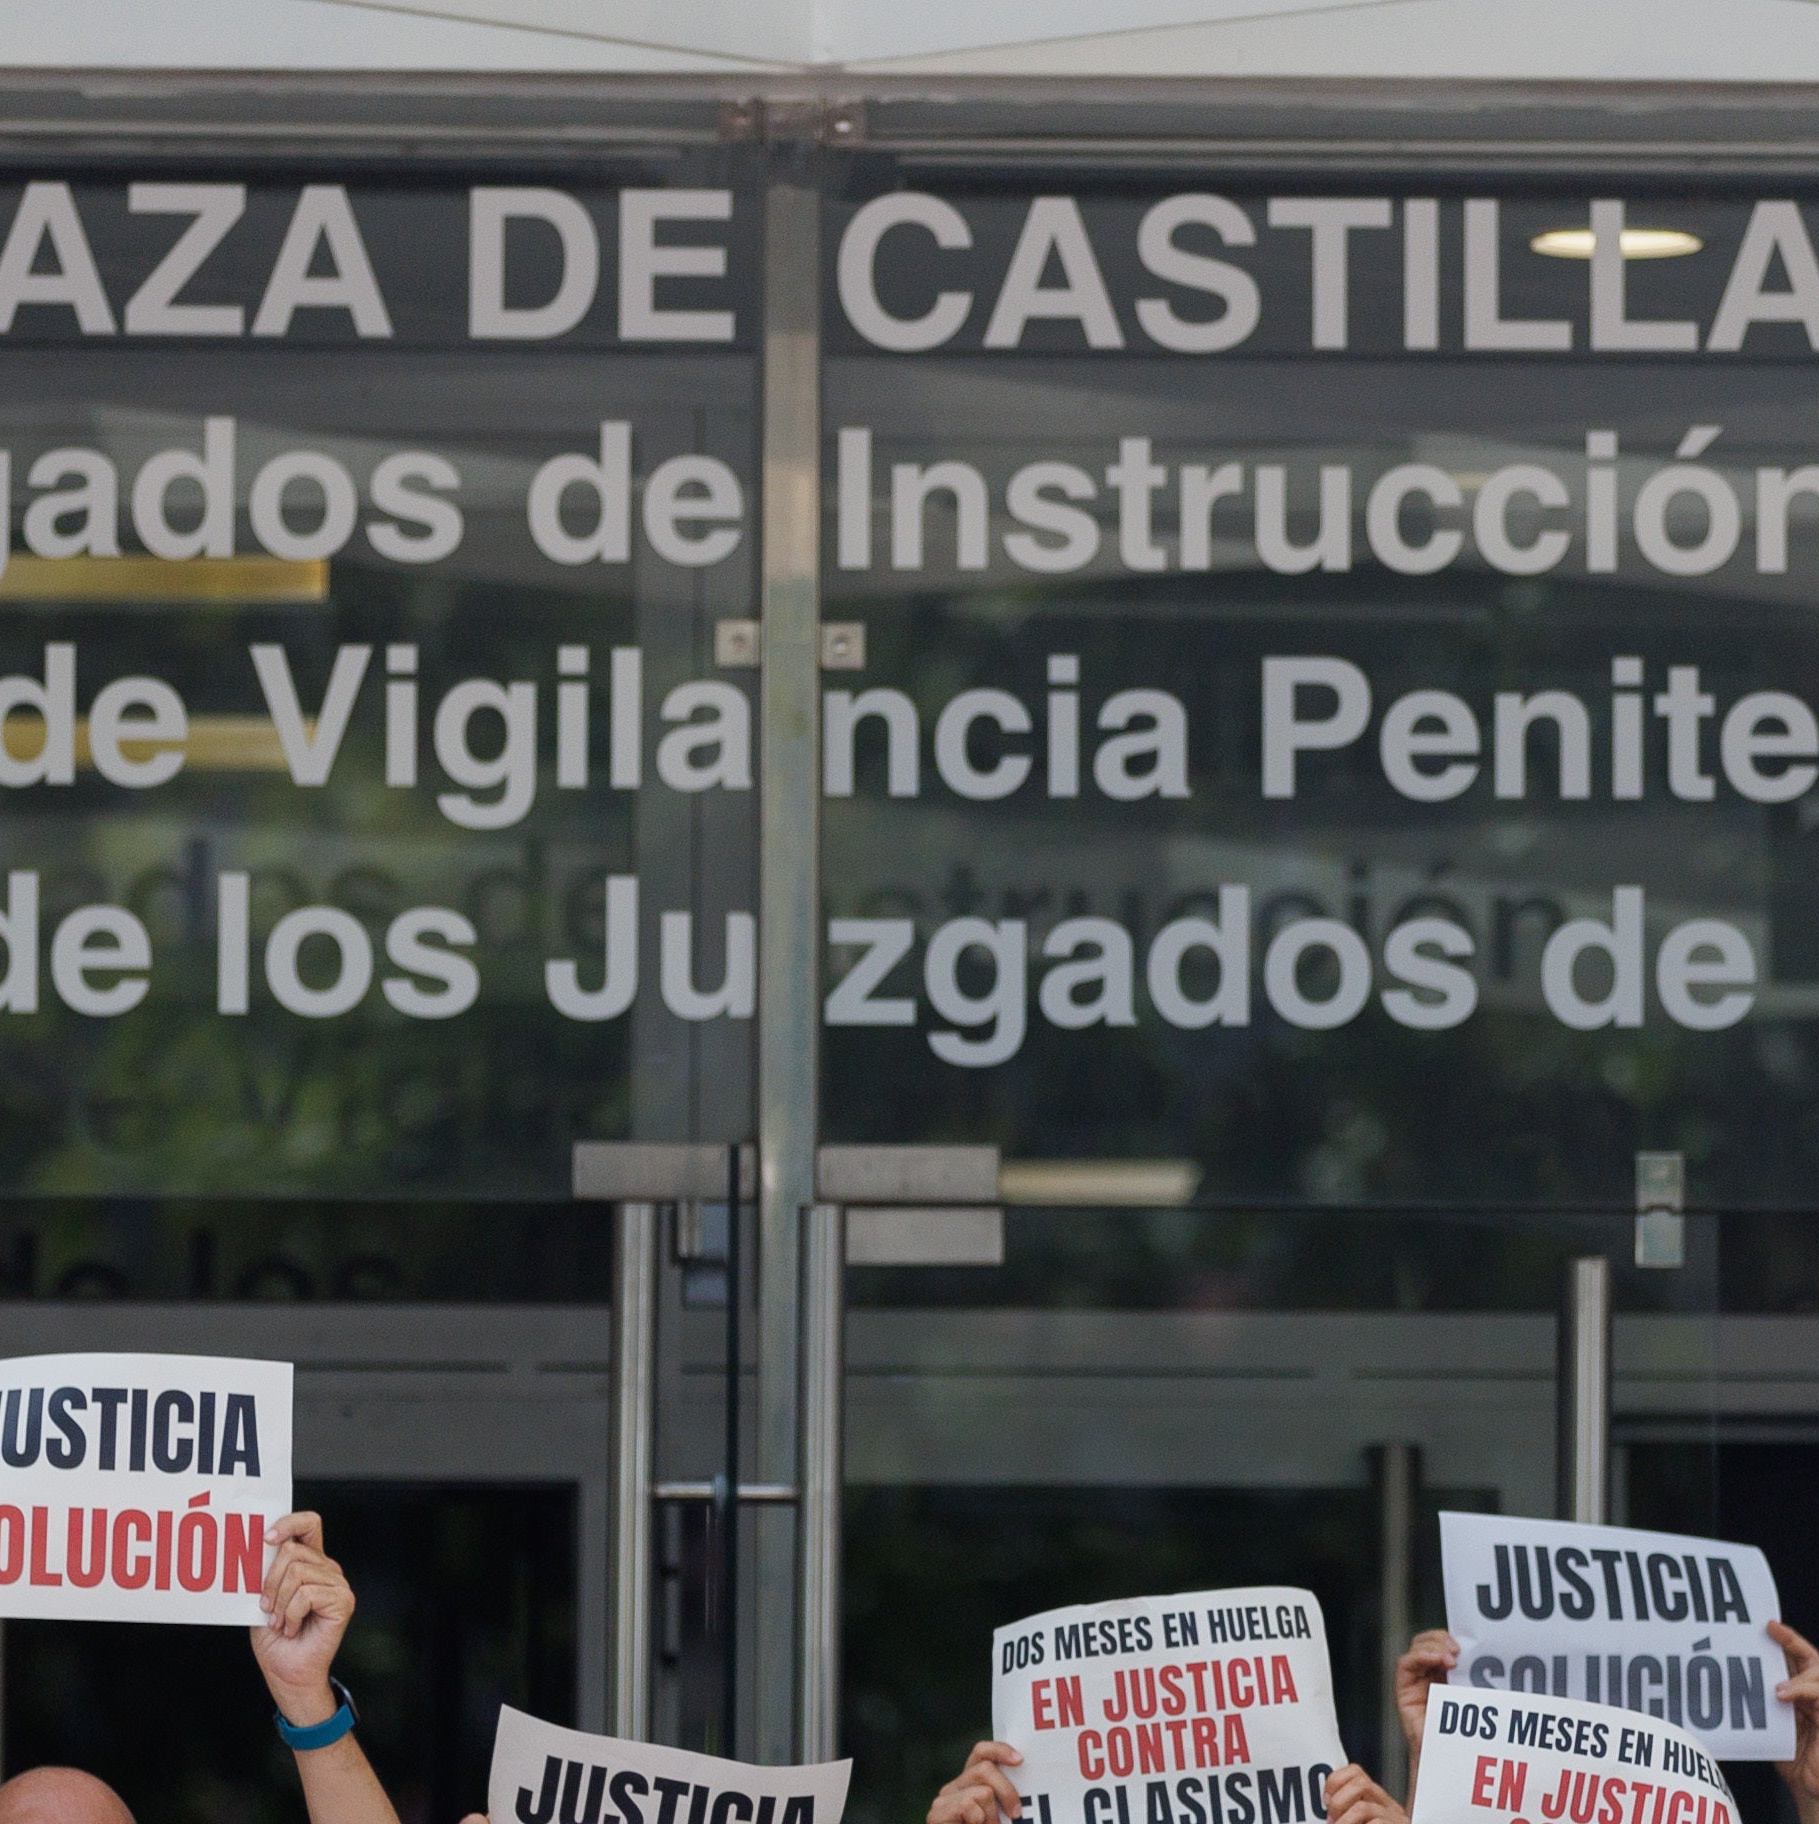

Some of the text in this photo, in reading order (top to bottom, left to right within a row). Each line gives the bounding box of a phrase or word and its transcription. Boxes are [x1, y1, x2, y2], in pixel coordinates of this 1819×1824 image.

[469, 189, 736, 341] DE
[527, 420, 743, 566] de
[219, 875, 477, 1019] los
[1538, 889, 1757, 1031] de
[1476, 1543, 1750, 1625] JUSTICIA
[1002, 1605, 1312, 1676] DOS MESES EN HUELGA
[1032, 1655, 1299, 1731] EN JUSTICIA
[1078, 1714, 1251, 1781] CONTRA
[1439, 1700, 1499, 1741] DOS
[1507, 1709, 1610, 1759] MESES
[1618, 1728, 1653, 1768] EN
[1471, 1755, 1528, 1813] EN
